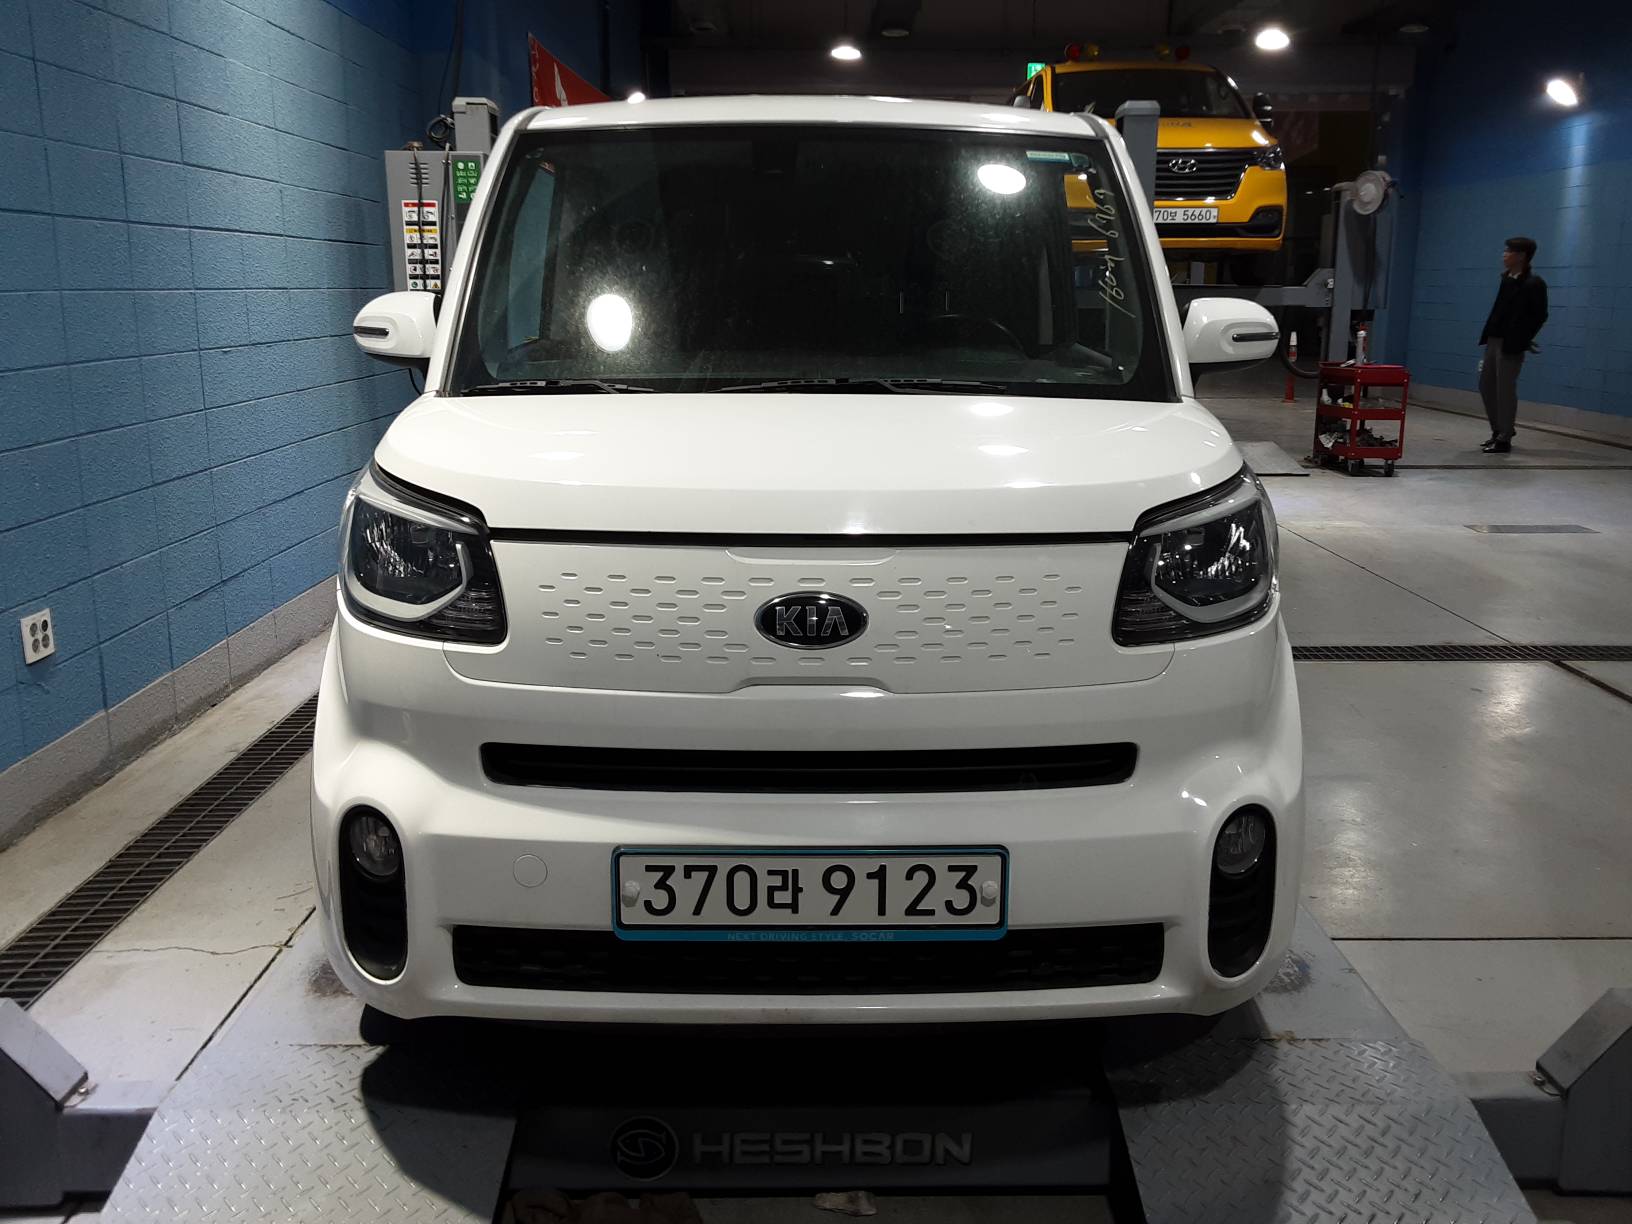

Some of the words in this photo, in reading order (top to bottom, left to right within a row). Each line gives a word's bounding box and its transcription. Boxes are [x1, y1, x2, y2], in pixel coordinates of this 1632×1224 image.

[1182, 209, 1212, 222] 5660
[775, 606, 849, 636] KIA
[643, 864, 804, 917] 370라
[821, 863, 979, 917] 9123
[692, 1132, 974, 1165] HESHBON
